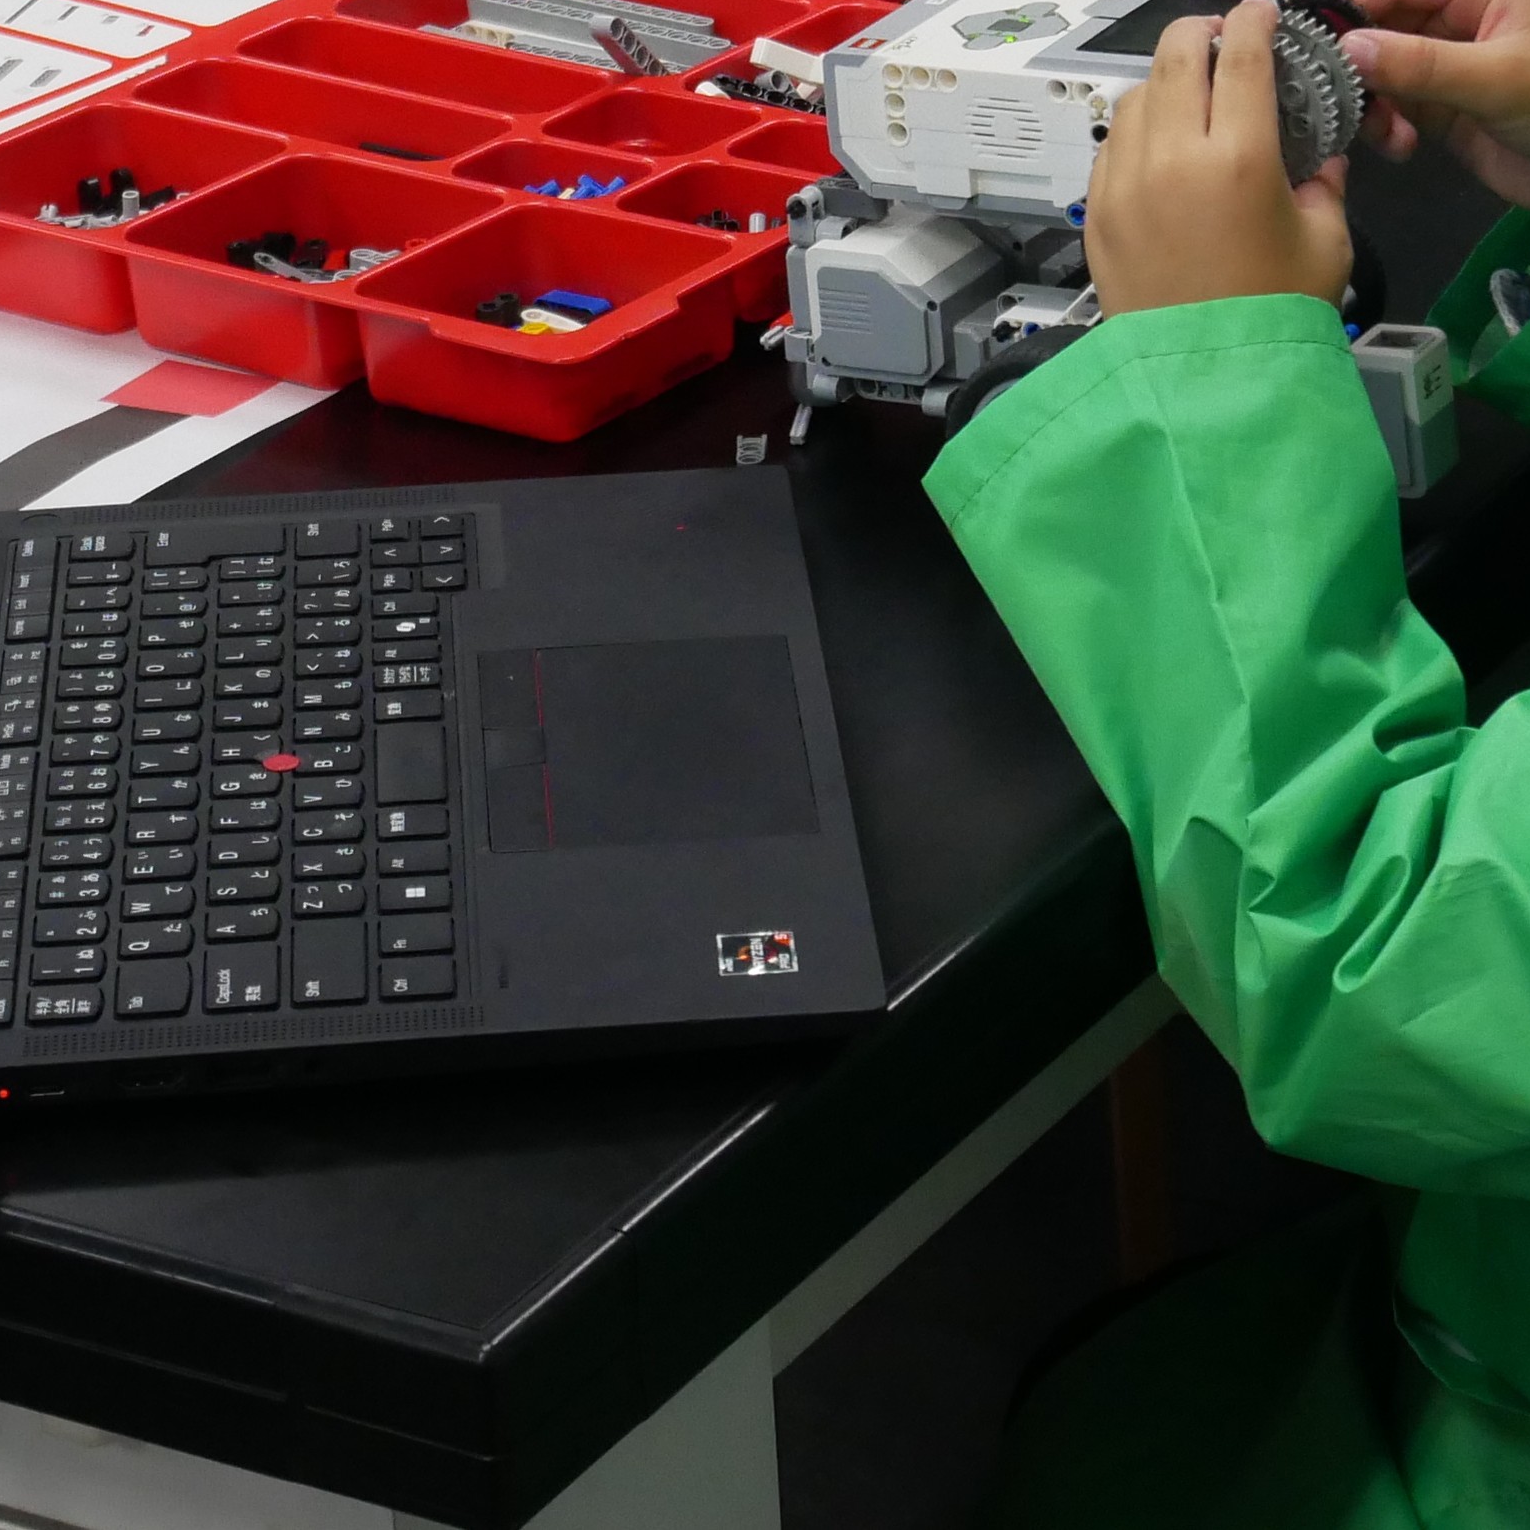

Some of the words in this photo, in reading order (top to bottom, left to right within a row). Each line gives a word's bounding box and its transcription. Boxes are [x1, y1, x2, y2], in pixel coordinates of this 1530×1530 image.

[307, 524, 319, 536] Shift
[157, 533, 169, 546] Enter
[177, 681, 191, 690] に
[304, 695, 322, 703] M
[94, 703, 111, 711] ゆ
[93, 735, 109, 743] や
[174, 746, 189, 754] ん
[336, 745, 350, 753] こ
[91, 768, 107, 776] お
[172, 780, 187, 788] か
[221, 782, 240, 791] G
[336, 779, 352, 788] ひ
[251, 801, 266, 809] は
[170, 815, 187, 823] す
[169, 849, 183, 858] い
[392, 859, 404, 868] Alt
[134, 866, 153, 874] E
[251, 870, 269, 878] と
[81, 873, 99, 882] あ
[131, 903, 150, 913] W
[251, 908, 268, 916] ち
[79, 910, 96, 920] ふ
[164, 923, 181, 932] た
[216, 925, 235, 933] A
[128, 941, 149, 950] Q
[393, 940, 406, 948] Fn
[216, 969, 232, 1003] CapsLock
[306, 981, 319, 996] Shift
[394, 979, 407, 991] Ctrl
[129, 997, 143, 1009] Tab
